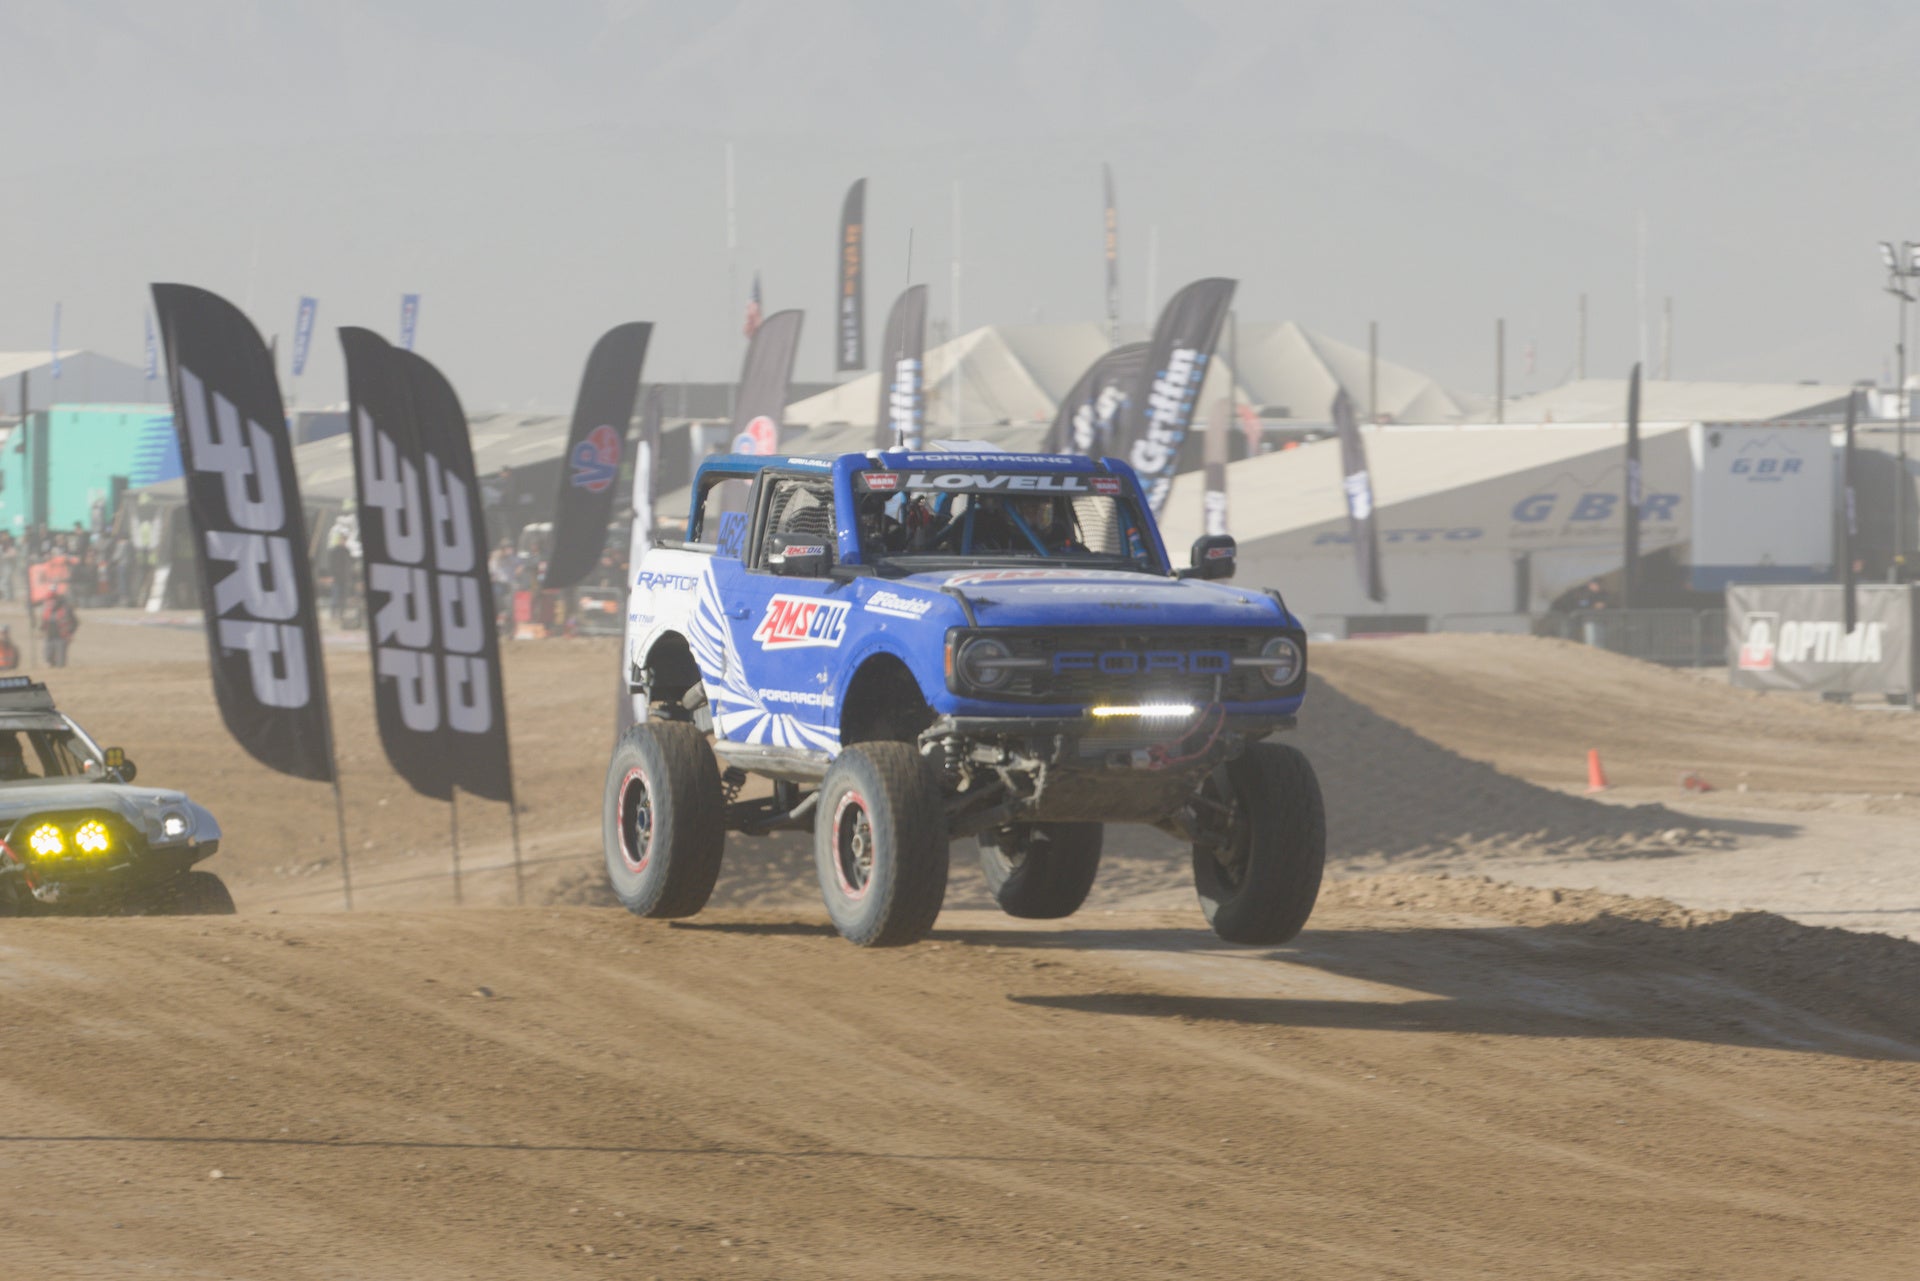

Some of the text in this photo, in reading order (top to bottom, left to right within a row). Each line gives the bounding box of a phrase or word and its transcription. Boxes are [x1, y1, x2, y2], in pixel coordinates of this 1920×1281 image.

[889, 359, 921, 449] riffin
[1130, 349, 1204, 473] Griffin
[907, 454, 1072, 464] FORD RACING
[905, 474, 1088, 491] LOVELL
[180, 365, 310, 708] PRP
[1313, 527, 1484, 545] NTTO
[787, 546, 822, 556] AMSOIL
[357, 404, 440, 733] PRP
[637, 571, 699, 591] RAPTOR
[760, 600, 844, 643] AMSOIL
[1776, 620, 1885, 663] OPTIMA
[1053, 650, 1231, 675] FORD
[758, 688, 790, 703] FORD
